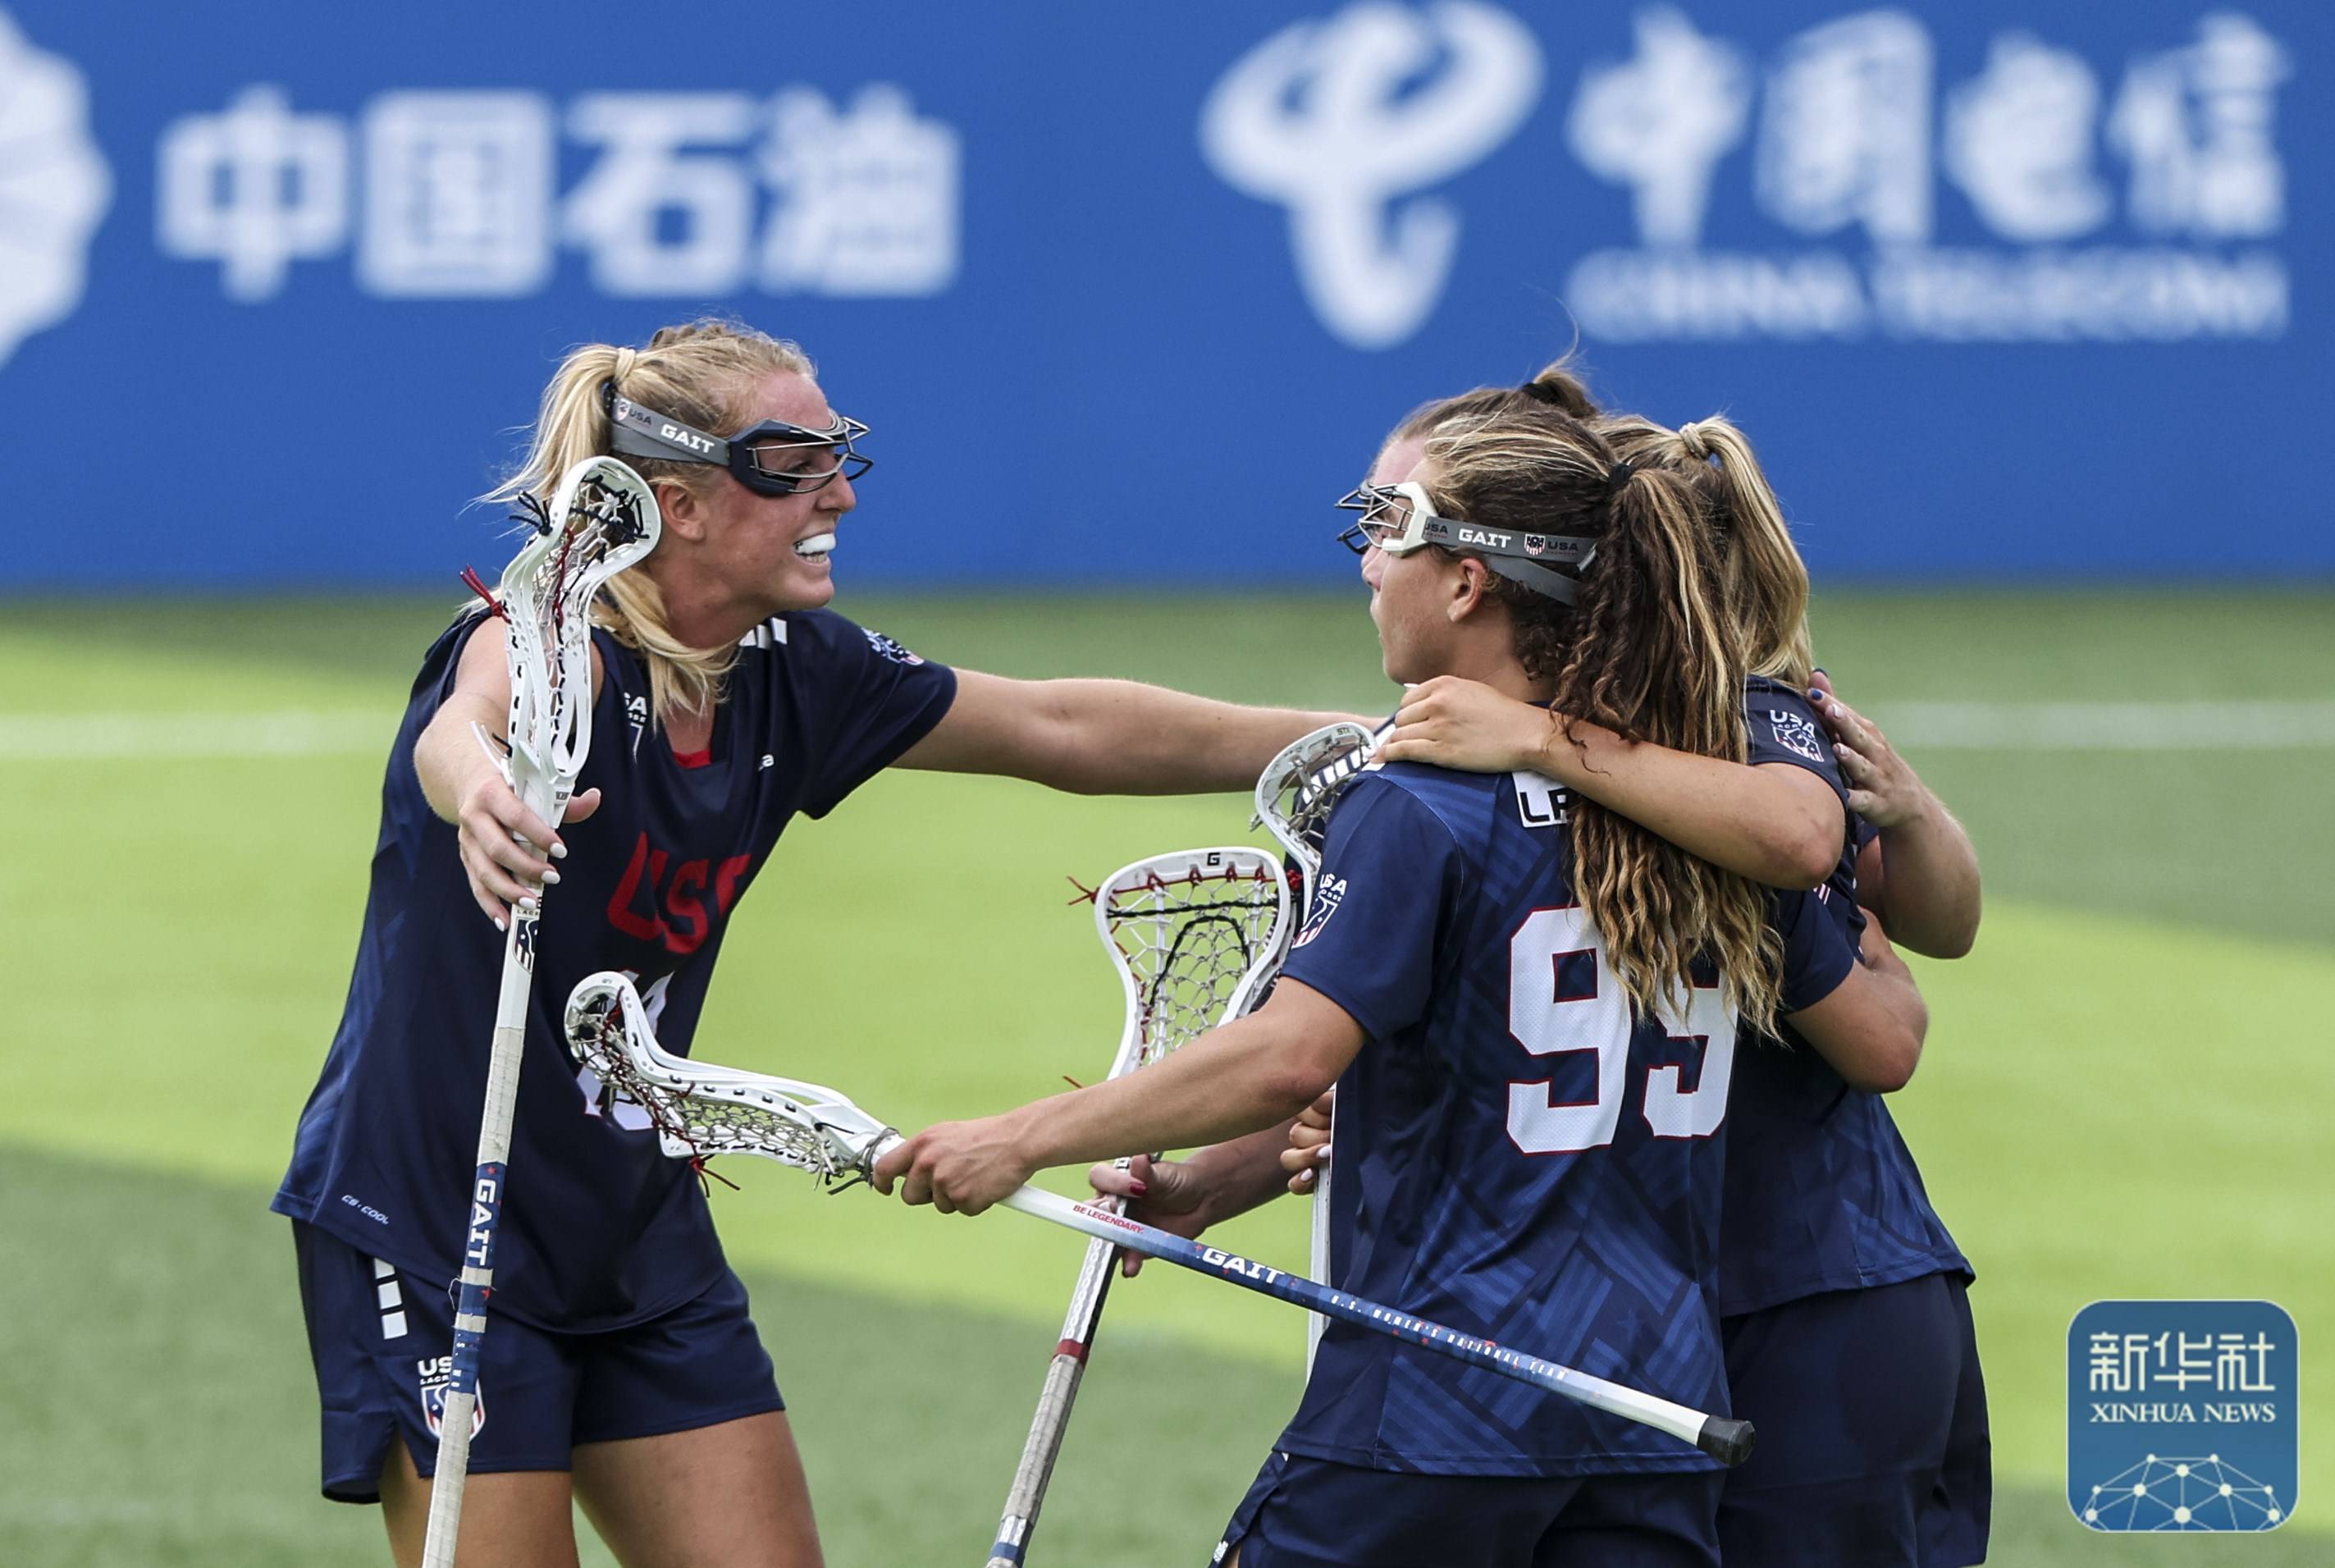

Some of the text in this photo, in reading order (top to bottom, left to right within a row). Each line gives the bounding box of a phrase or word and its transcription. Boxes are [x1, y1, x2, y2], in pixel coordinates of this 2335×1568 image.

[156, 82, 963, 300] 中国石油
[628, 409, 652, 425] USA
[660, 423, 715, 453] GAIT
[1458, 528, 1511, 548] GAIT
[1548, 541, 1579, 551] USA
[1207, 852, 1221, 866] G
[1506, 903, 1739, 1157] 99
[468, 1178, 496, 1266] GAIT
[1072, 1204, 1086, 1214] BE
[1202, 1247, 1286, 1284] GAIT
[1446, 1333, 1519, 1366] NATIONAL
[1529, 1360, 1568, 1380] TEAM
